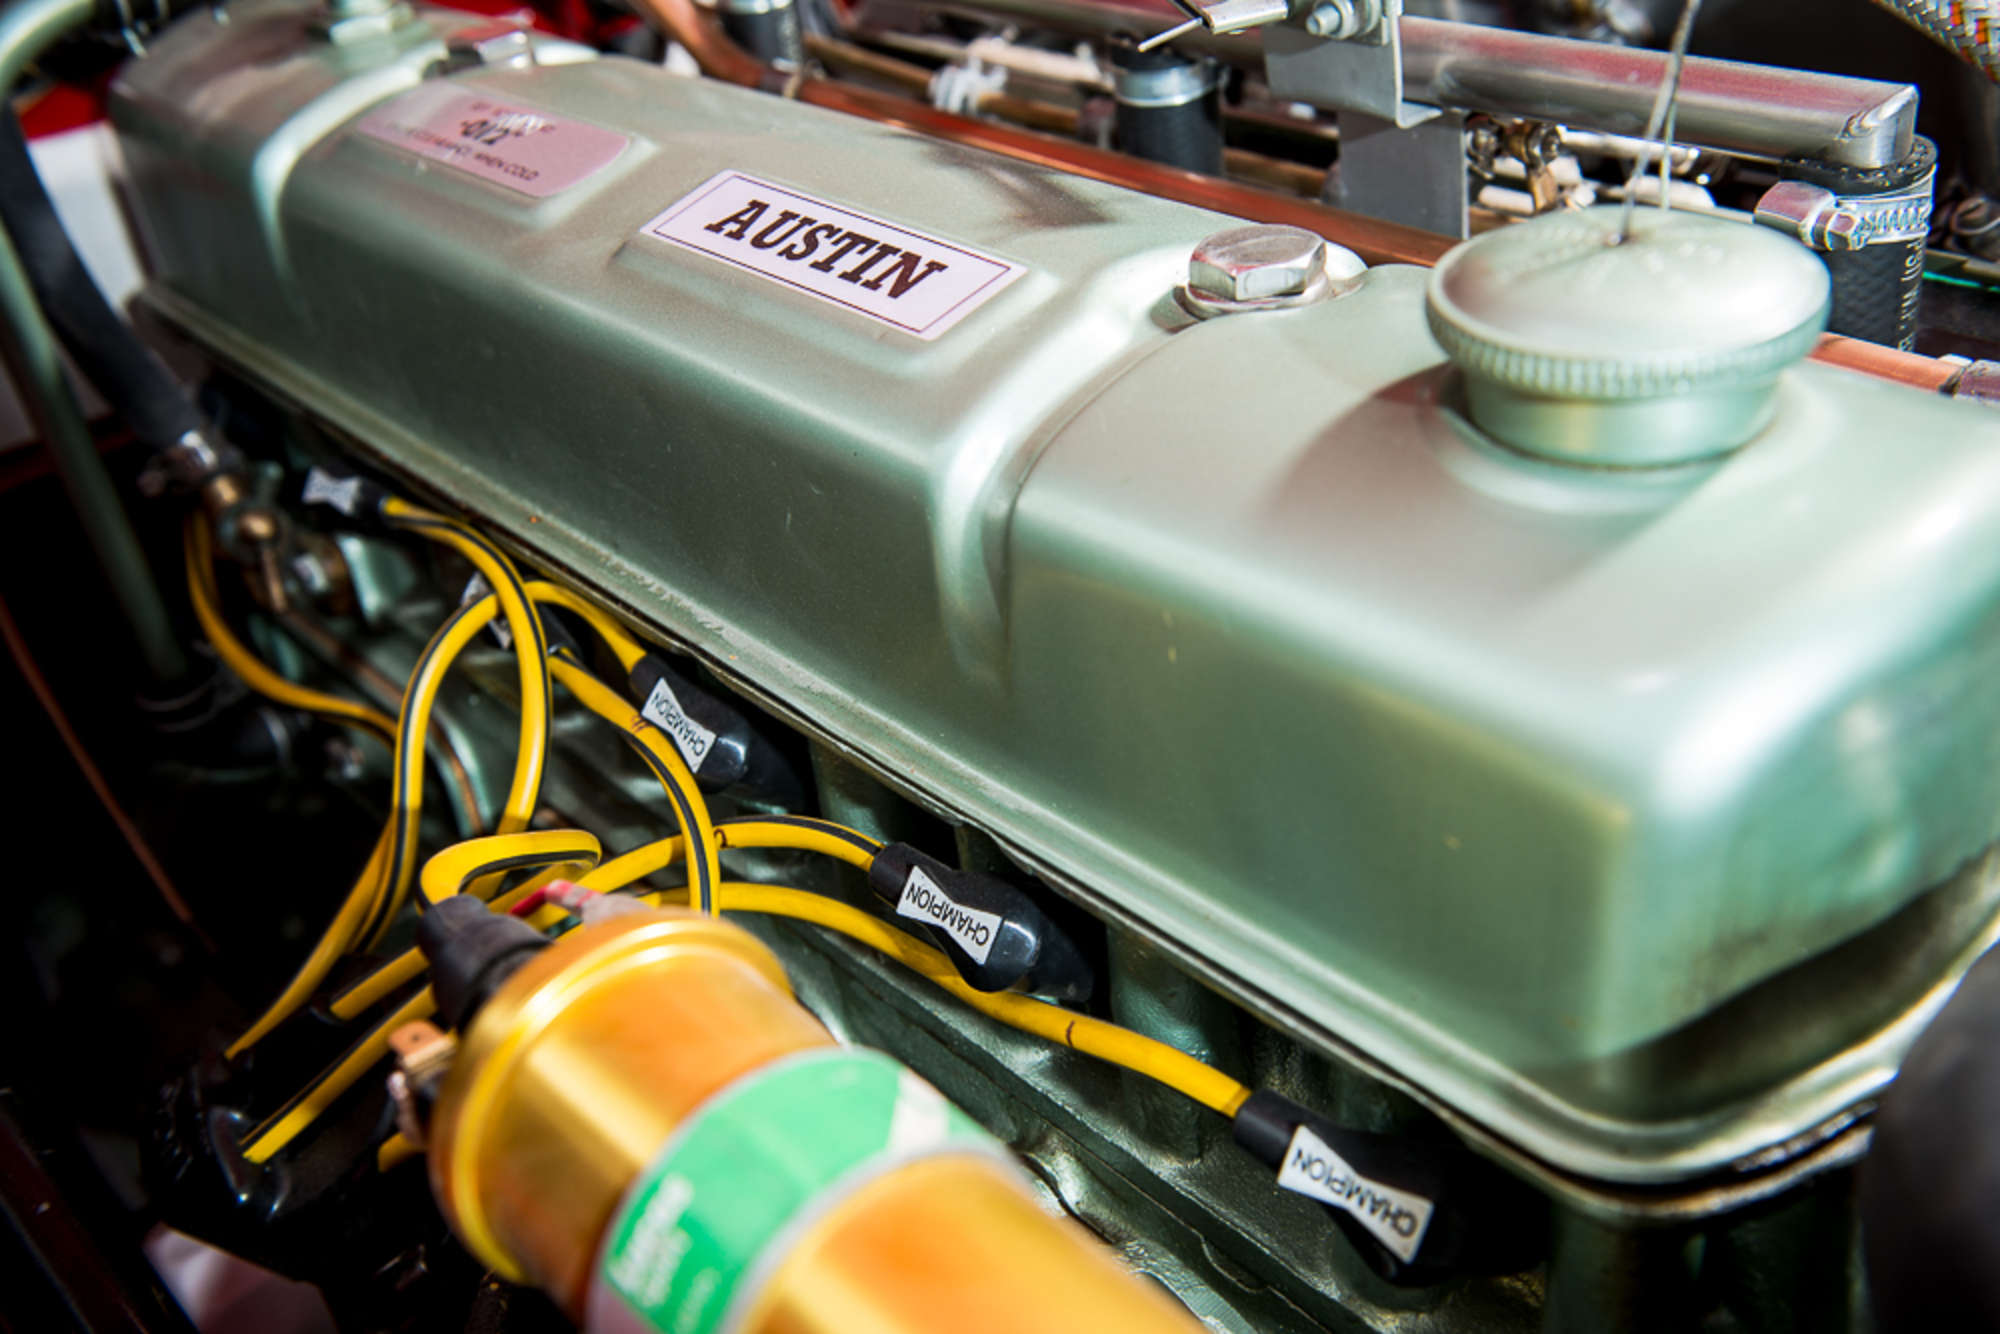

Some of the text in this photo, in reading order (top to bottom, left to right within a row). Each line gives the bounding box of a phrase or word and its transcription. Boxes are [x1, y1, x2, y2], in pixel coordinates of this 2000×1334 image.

[704, 199, 948, 299] AUSTIN
[650, 691, 706, 757] CHAMPION
[906, 882, 990, 946] CHAMPION
[1292, 1148, 1419, 1237] CHAMPION
